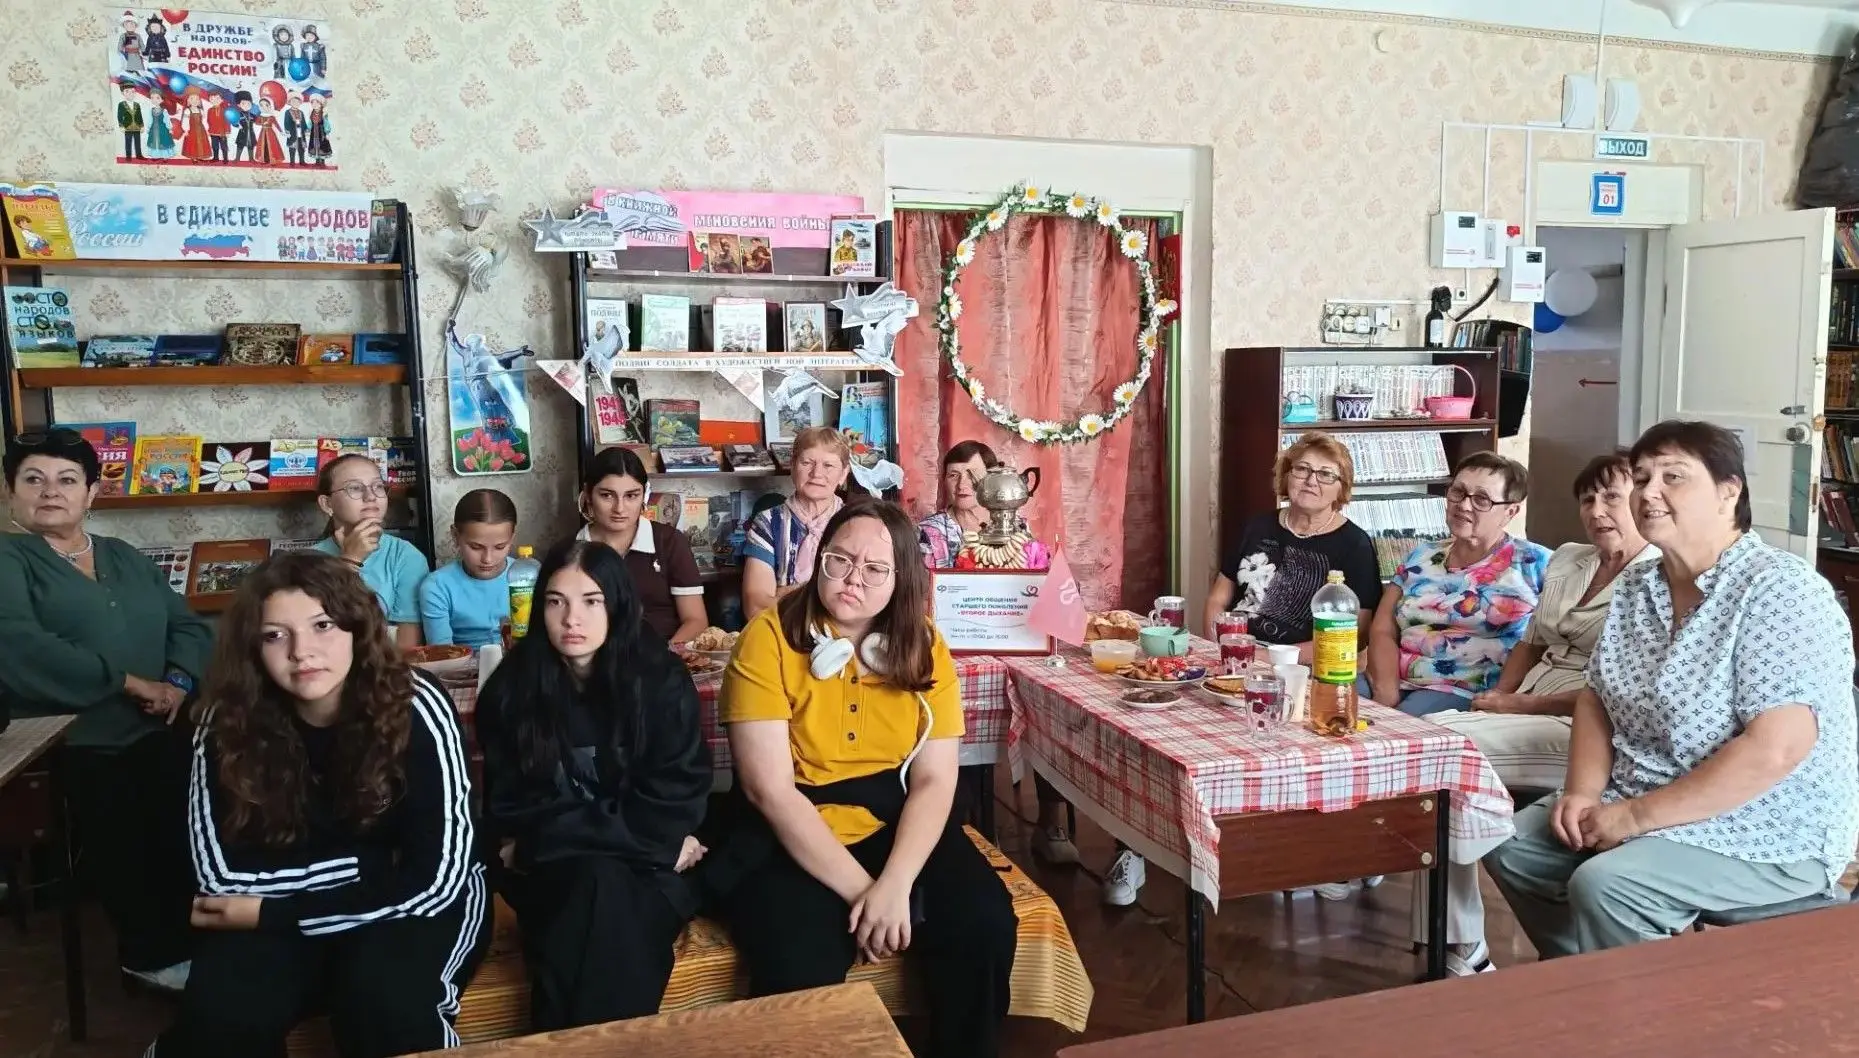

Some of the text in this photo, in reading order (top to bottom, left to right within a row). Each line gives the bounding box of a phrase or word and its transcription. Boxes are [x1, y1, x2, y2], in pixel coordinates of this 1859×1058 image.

[183, 23, 254, 36] В ДРУЖБЕ
[178, 46, 265, 62] ЕДИНСТВО
[188, 63, 257, 77] РОССИИ!
[1599, 140, 1644, 155] ВЫХОД
[1603, 194, 1614, 204] 01
[617, 197, 678, 217] КНИЖНОЙ
[694, 214, 776, 229] МГНОВЕНИЯ
[36, 291, 68, 307] СТО
[14, 306, 70, 316] народов
[17, 314, 50, 330] СТО
[19, 330, 75, 339] языков
[656, 359, 699, 367] СОЛДАТА
[599, 411, 625, 426] 1945
